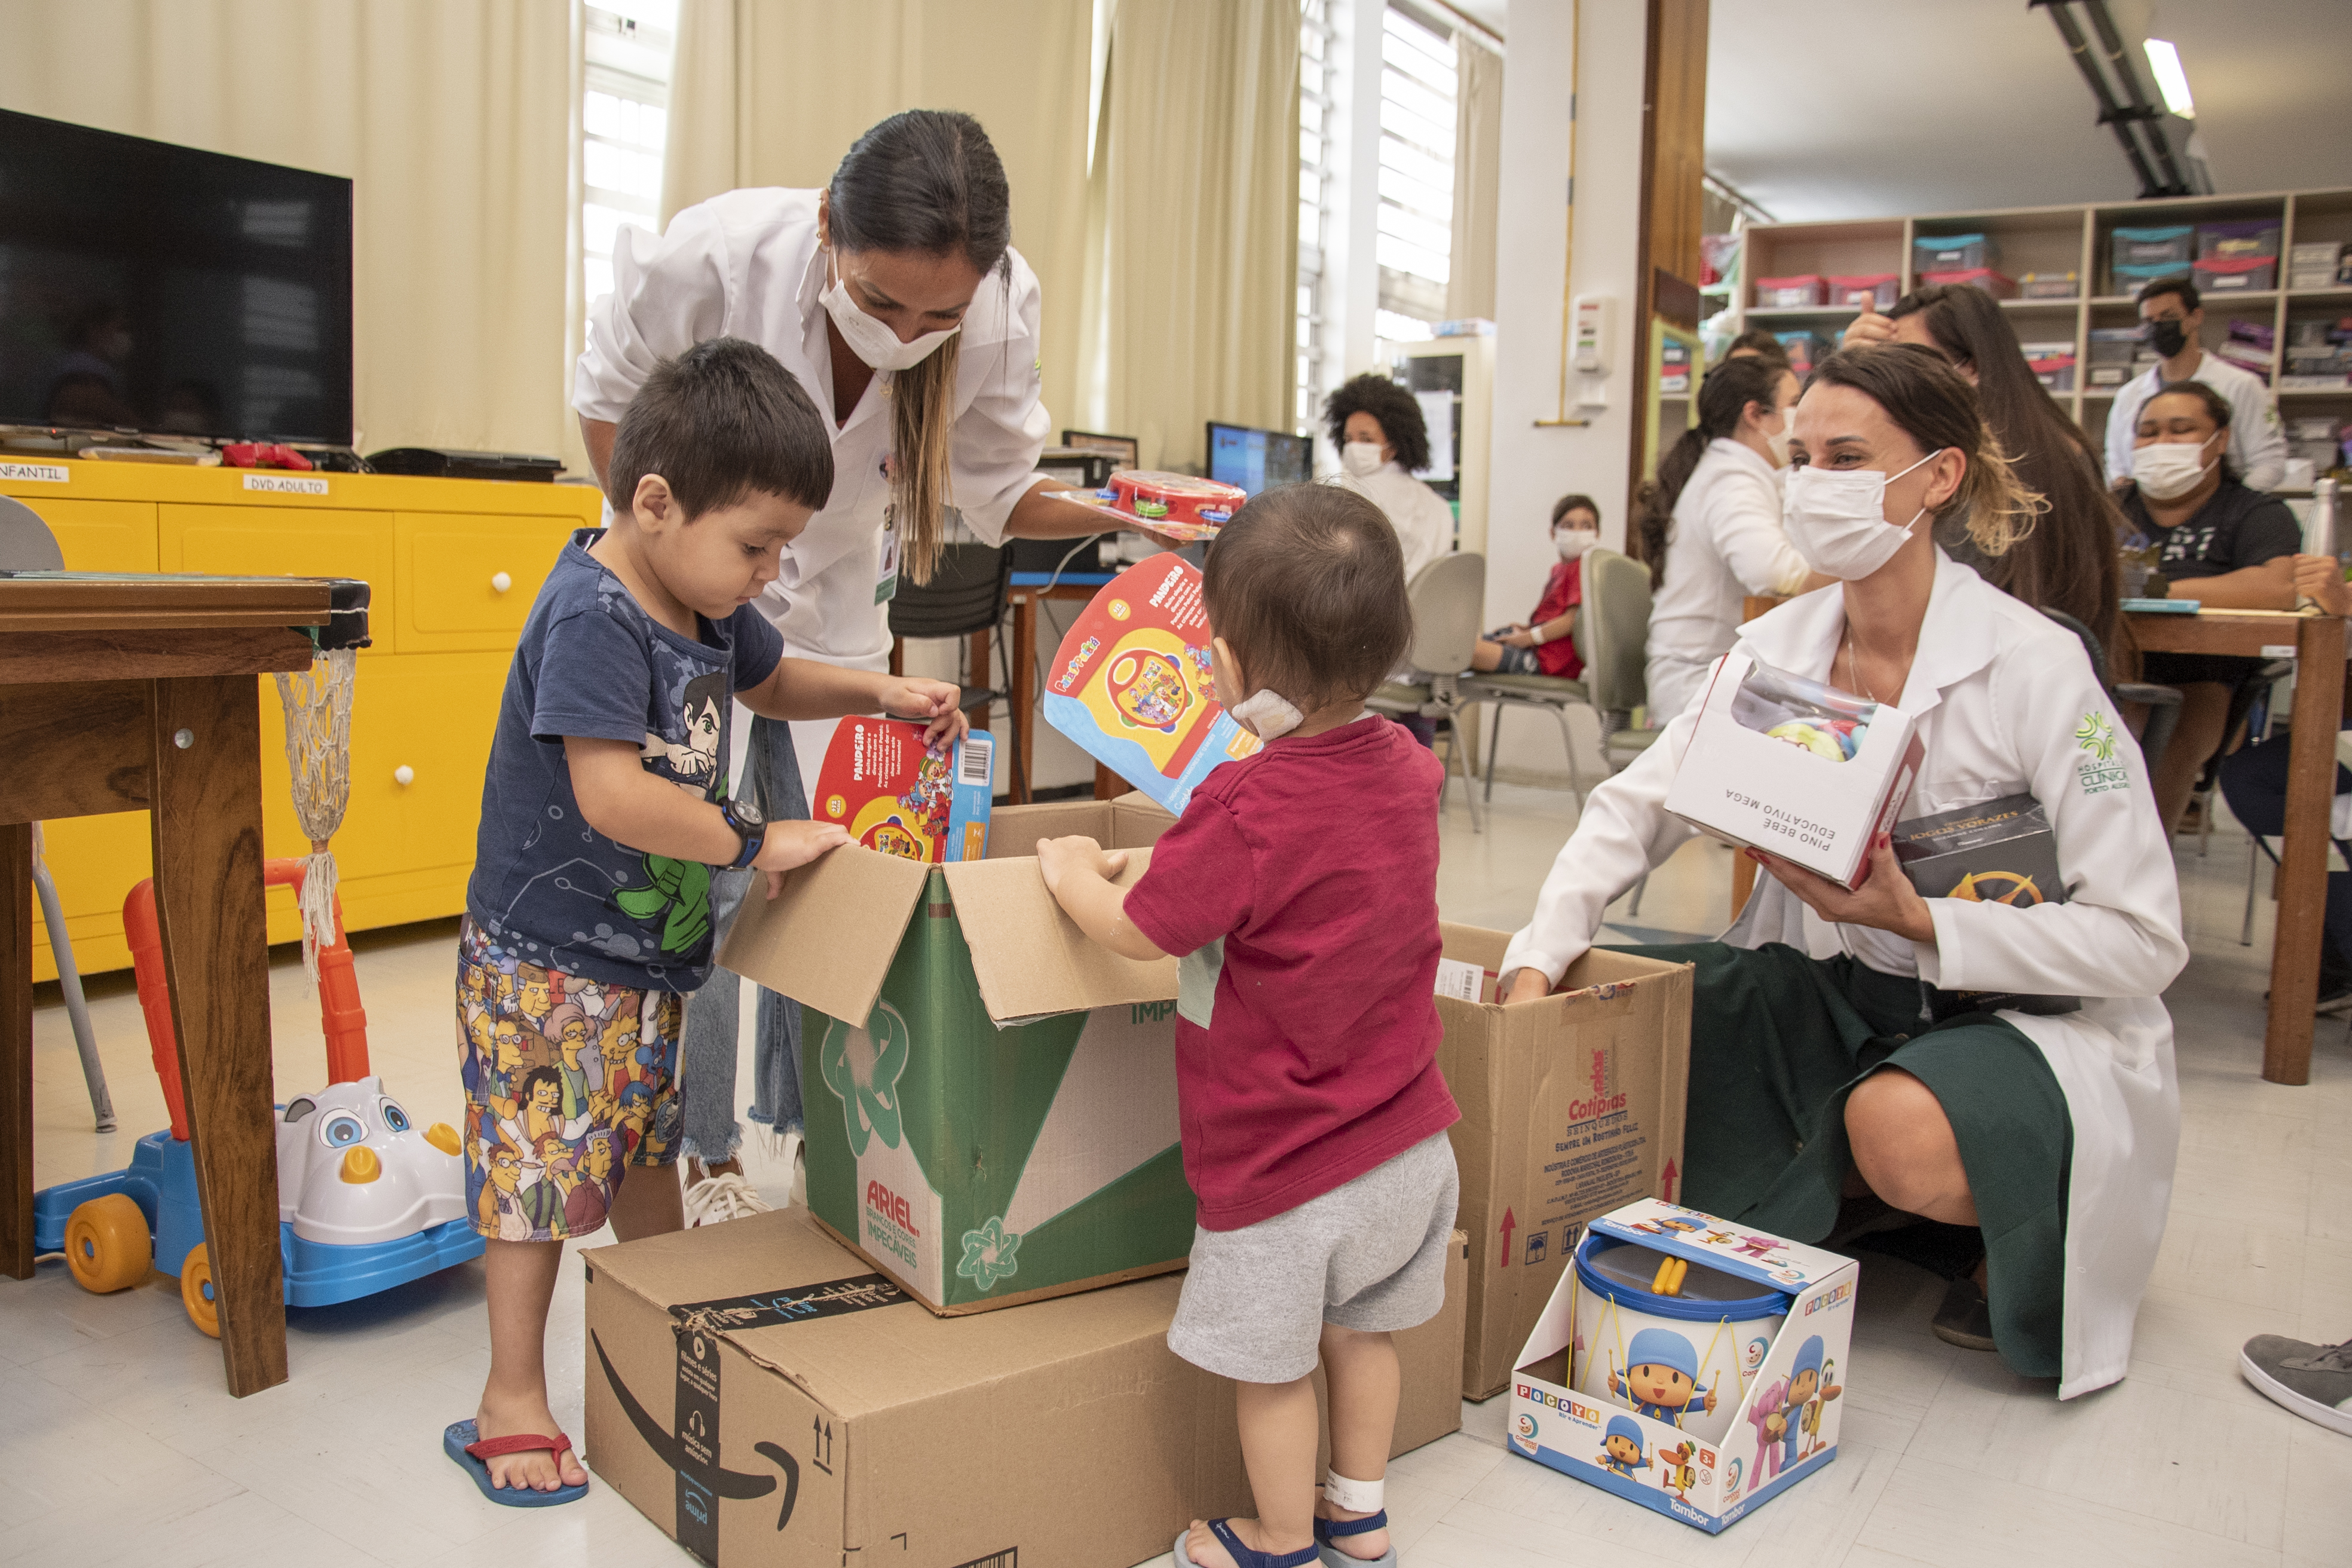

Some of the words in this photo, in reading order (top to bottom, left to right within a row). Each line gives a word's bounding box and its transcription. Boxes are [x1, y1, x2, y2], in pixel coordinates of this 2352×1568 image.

[252, 478, 274, 490] DVD
[278, 480, 323, 494] ADULTO
[1164, 595, 1175, 609] Muita
[1174, 581, 1186, 596] alegria
[1171, 595, 1185, 612] diversão
[1183, 586, 1192, 596] com
[1170, 606, 1186, 626] Pandeiro
[1183, 593, 1195, 607] Patati
[1181, 605, 1196, 624] crianças
[1189, 614, 1198, 626] show
[886, 724, 889, 733] um
[1204, 733, 1216, 748] MESES
[1726, 789, 1760, 809] MEGA
[1763, 805, 1836, 840] EDUCATIVO
[1957, 810, 2018, 829] VORAZES
[1800, 834, 1831, 852] PINO
[1567, 1113, 1628, 1137] BRINQUEDOS
[1555, 1139, 1581, 1152] SEMPRE
[1582, 1136, 1591, 1146] UM
[866, 1206, 892, 1232] BRANCOS
[893, 1224, 896, 1235] E
[897, 1227, 916, 1249] CORES
[1603, 1220, 1648, 1236] Tambor
[868, 1220, 917, 1269] IMPECÁVEIS
[1805, 1281, 1851, 1316] POCOYO
[681, 1350, 697, 1368] filmes
[702, 1366, 717, 1382] séries
[682, 1365, 693, 1377] assista
[700, 1377, 716, 1392] qualquer
[693, 1382, 709, 1396] qualquer
[709, 1391, 718, 1402] hora
[1518, 1385, 1598, 1422] POCOYO
[682, 1431, 700, 1450] música
[701, 1445, 712, 1458] sem
[1515, 1435, 1538, 1447] Cardoso
[685, 1444, 708, 1466] anúncios
[1703, 1454, 1712, 1465] 3+
[685, 1500, 707, 1525] prime
[1670, 1498, 1709, 1526] Tambor
[1721, 1503, 1745, 1526] Tambor
